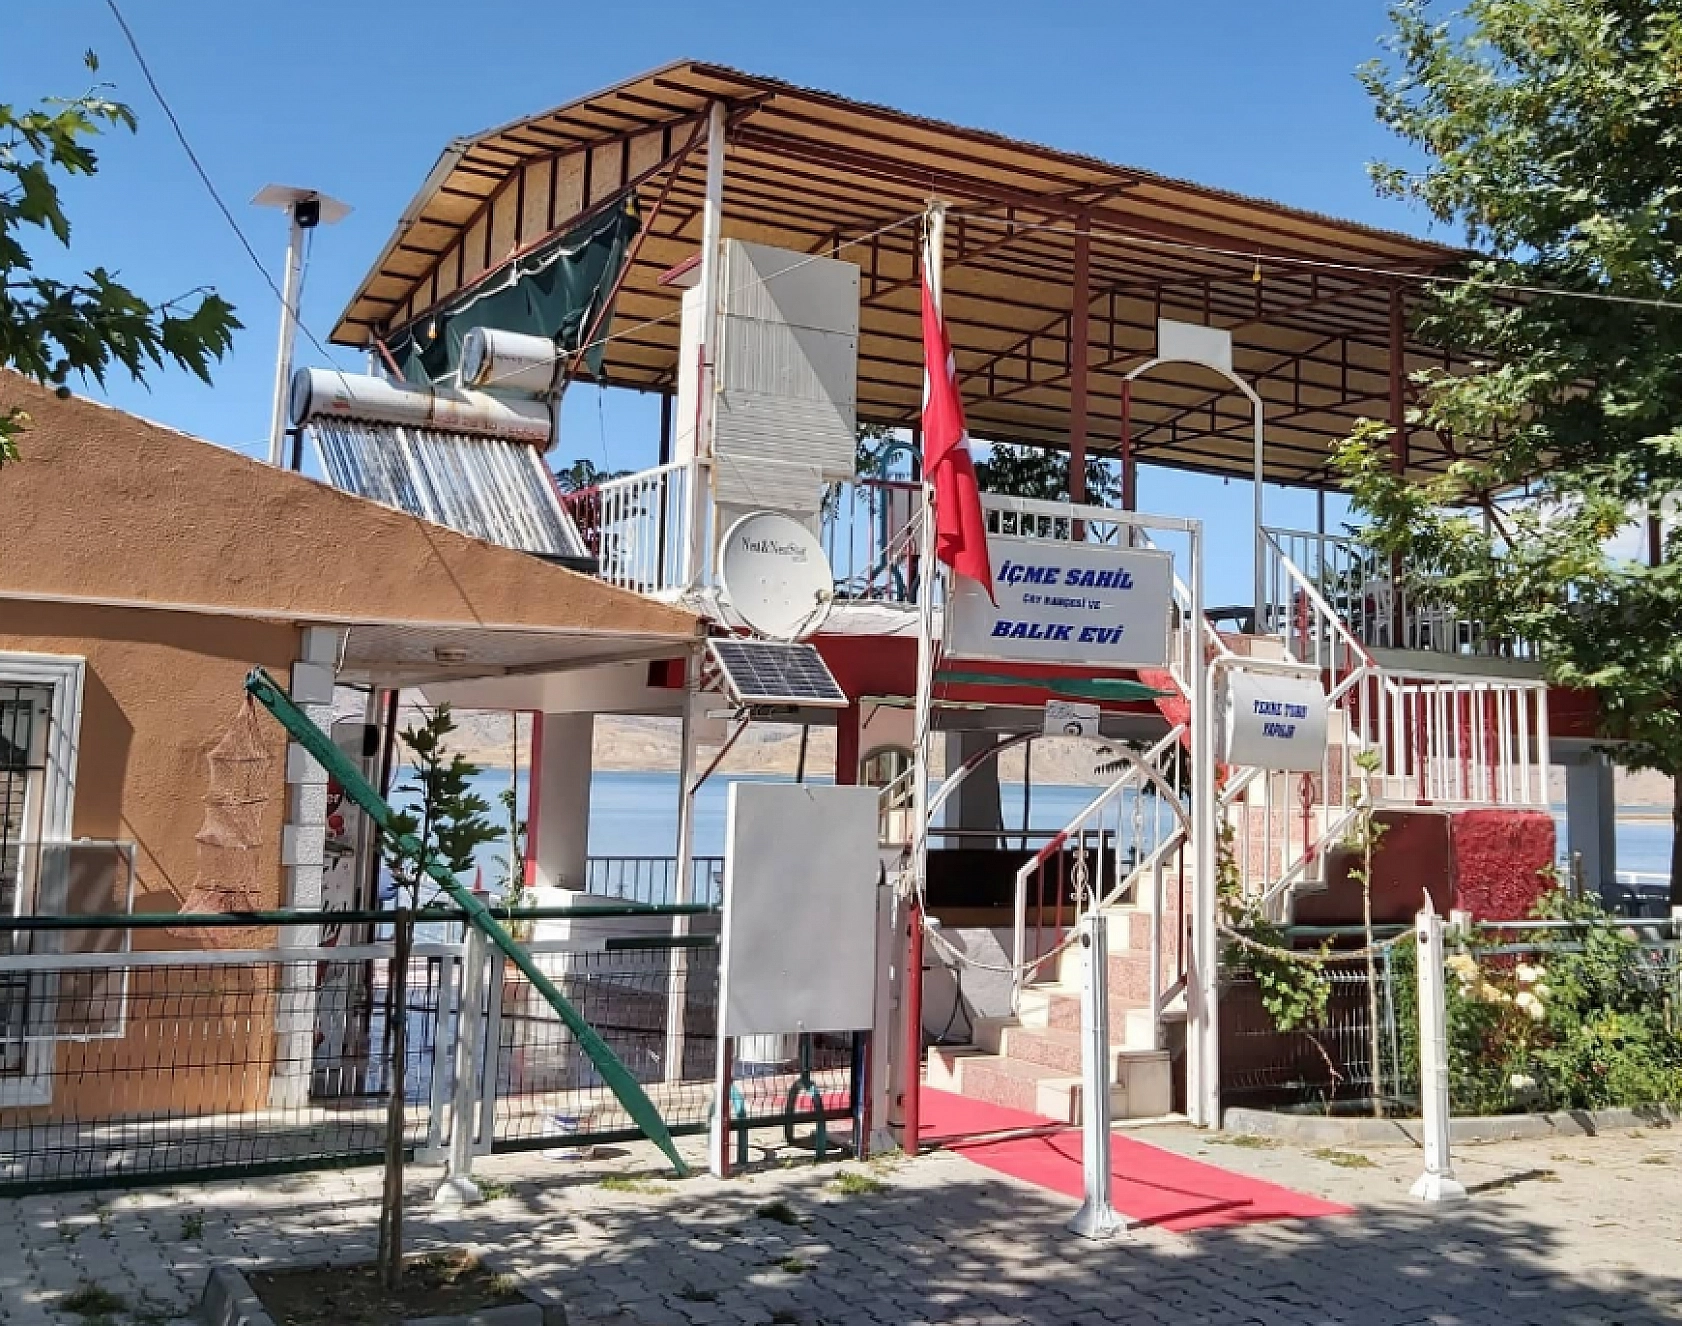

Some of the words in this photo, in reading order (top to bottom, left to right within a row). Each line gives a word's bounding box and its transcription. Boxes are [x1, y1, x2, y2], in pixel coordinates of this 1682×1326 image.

[997, 560, 1060, 587] İÇME
[1064, 567, 1133, 590] SAHİL
[991, 619, 1074, 641] BALIK
[1077, 624, 1124, 644] EVİ
